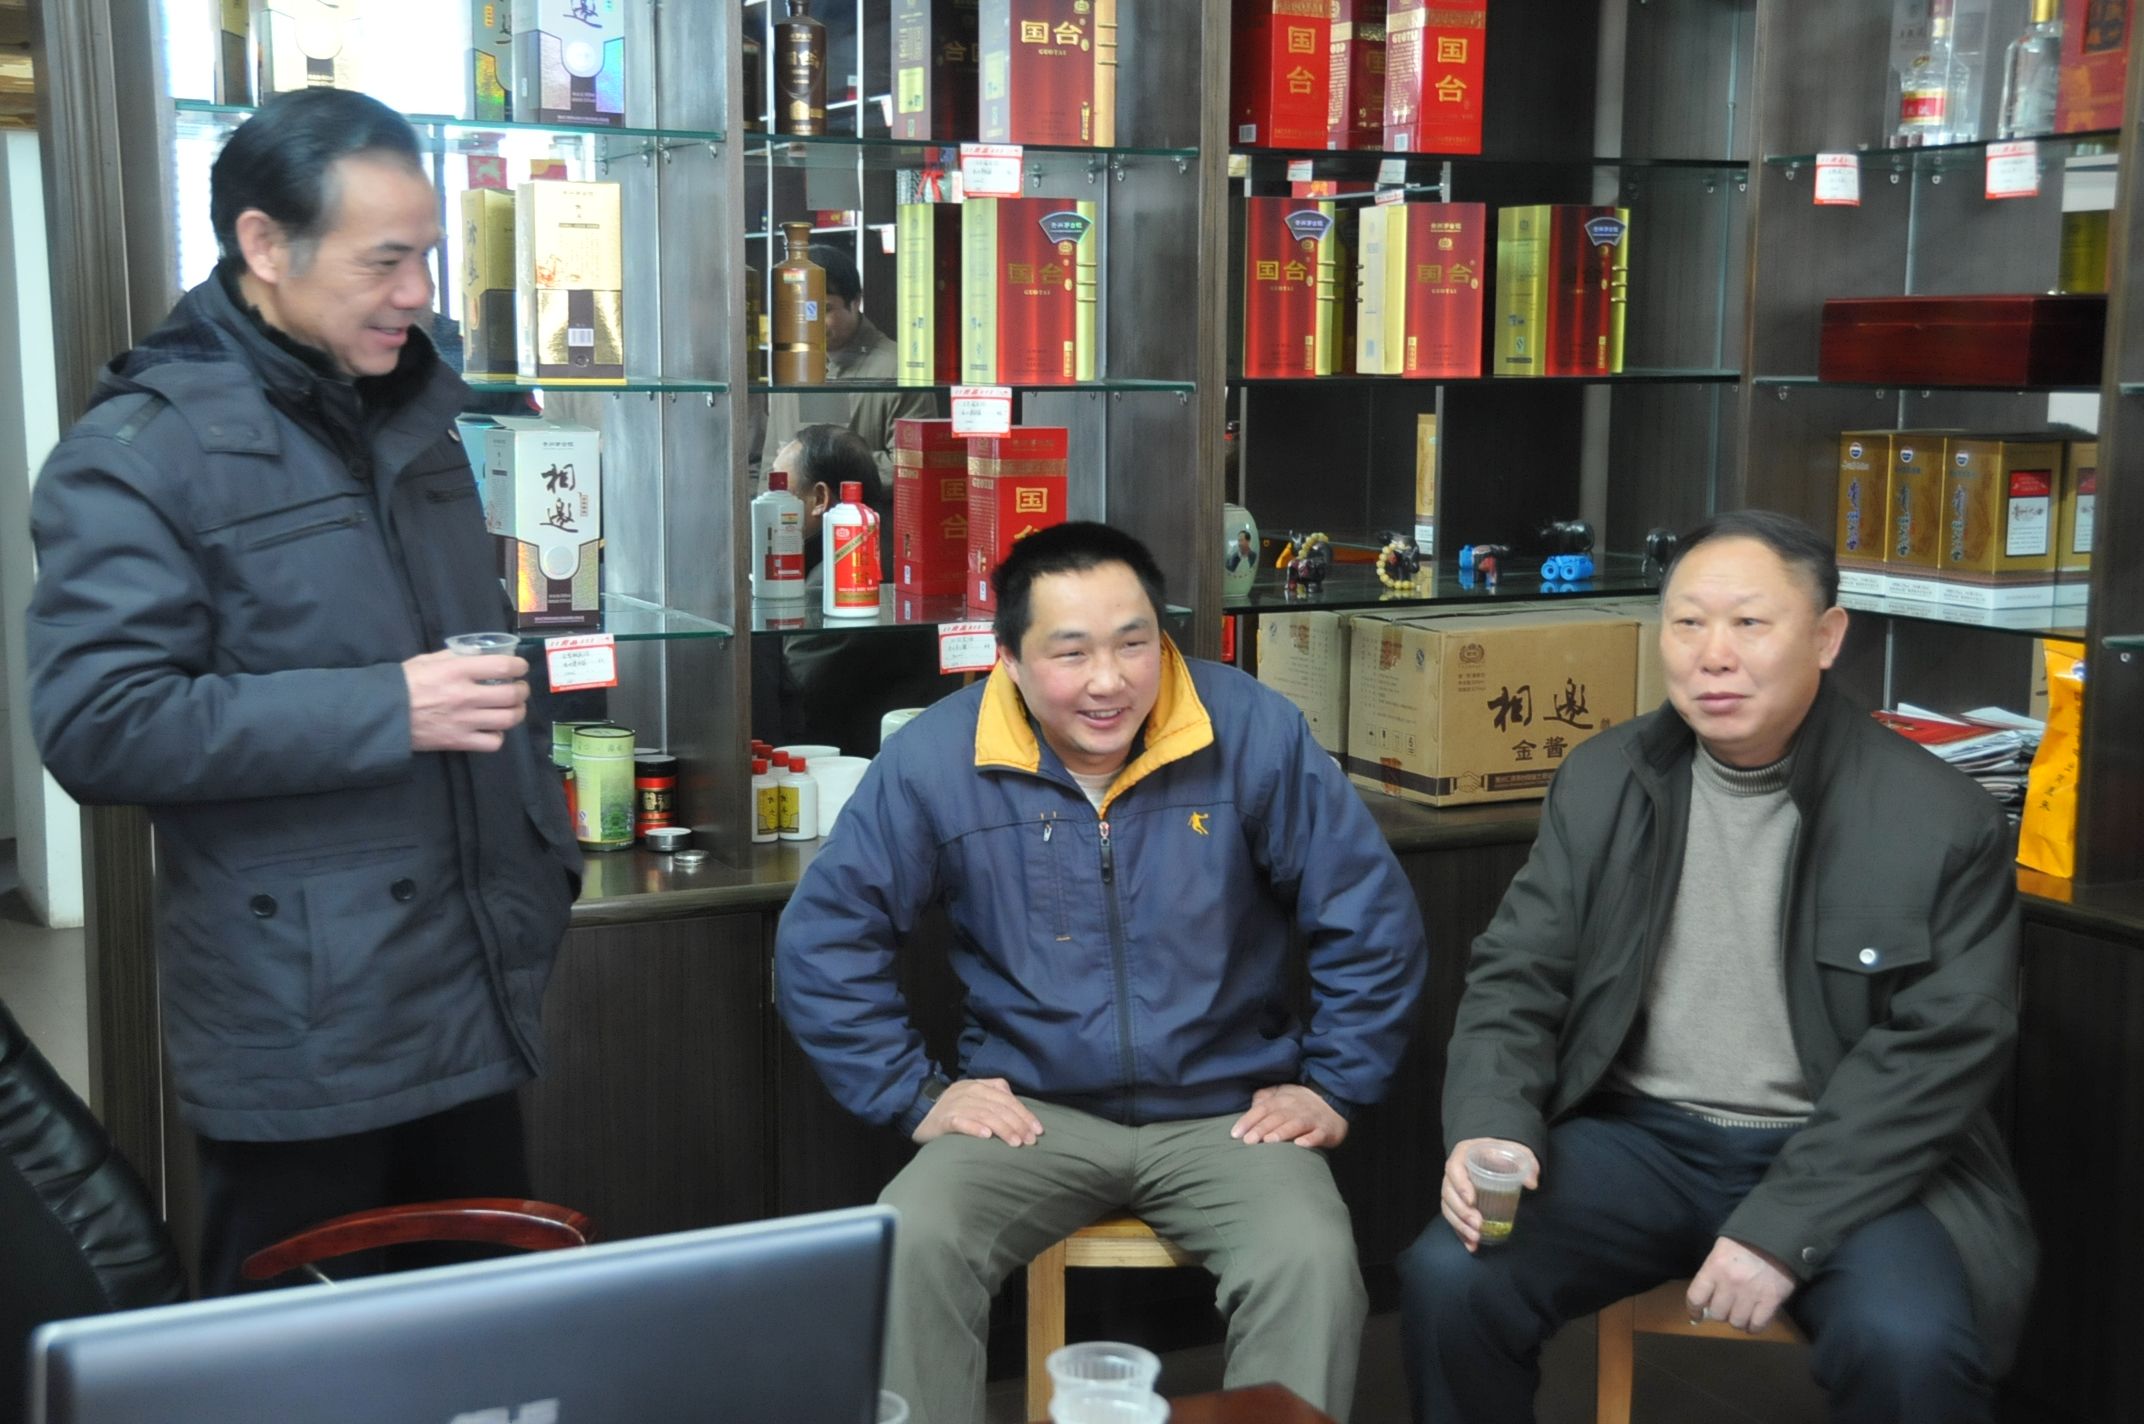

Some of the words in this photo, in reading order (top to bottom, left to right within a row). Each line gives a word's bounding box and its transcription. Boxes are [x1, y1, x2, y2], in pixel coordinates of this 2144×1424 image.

[1020, 20, 1083, 46] 国台
[1286, 26, 1316, 94] 国台
[1435, 36, 1467, 102] 国台
[1008, 262, 1064, 285] 国台
[1256, 260, 1308, 281] 国台
[1418, 264, 1473, 284] 国台
[540, 463, 579, 533] 相邀
[1487, 677, 1594, 733] 相邀
[1512, 736, 1568, 761] 金酱
